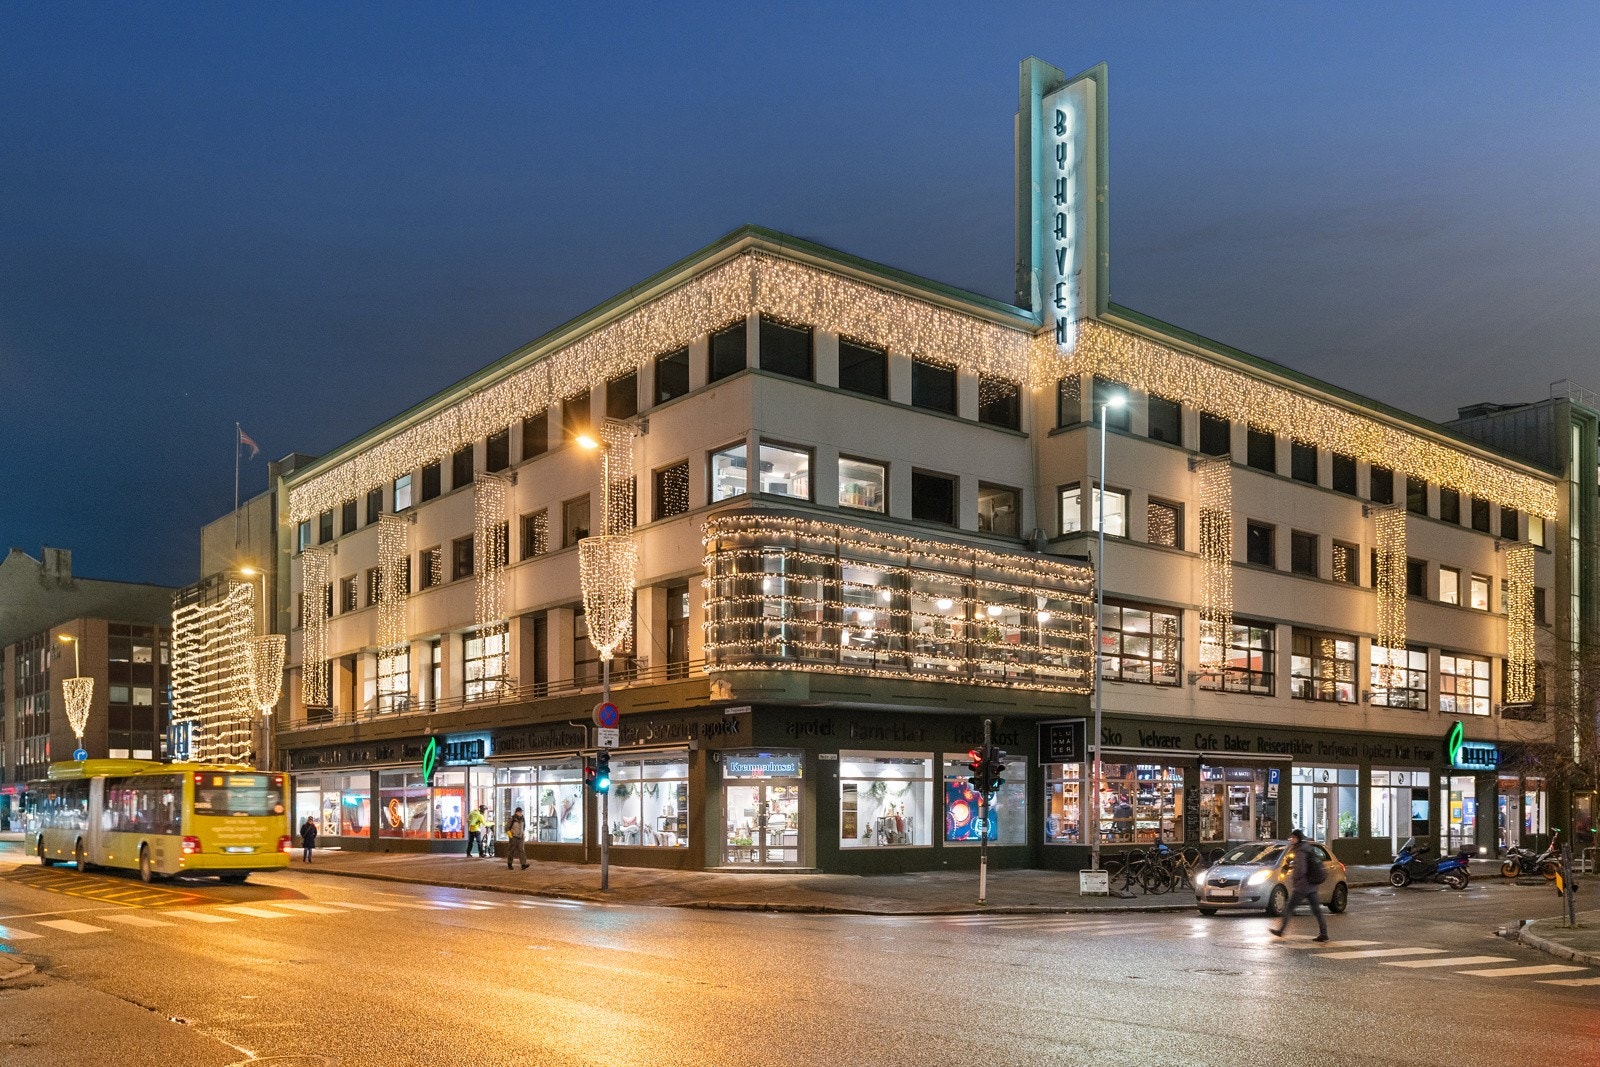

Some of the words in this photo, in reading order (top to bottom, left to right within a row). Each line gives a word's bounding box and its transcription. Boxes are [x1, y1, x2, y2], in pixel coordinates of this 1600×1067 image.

[1054, 109, 1068, 346] BYHAVEN
[702, 716, 741, 740] apotek
[1100, 728, 1122, 746] Sko
[1139, 729, 1181, 748] Velvære
[1195, 733, 1218, 750] Cafe
[1225, 735, 1250, 751] Baker
[1258, 737, 1313, 755] Reiseartikler
[1271, 771, 1278, 782] P
